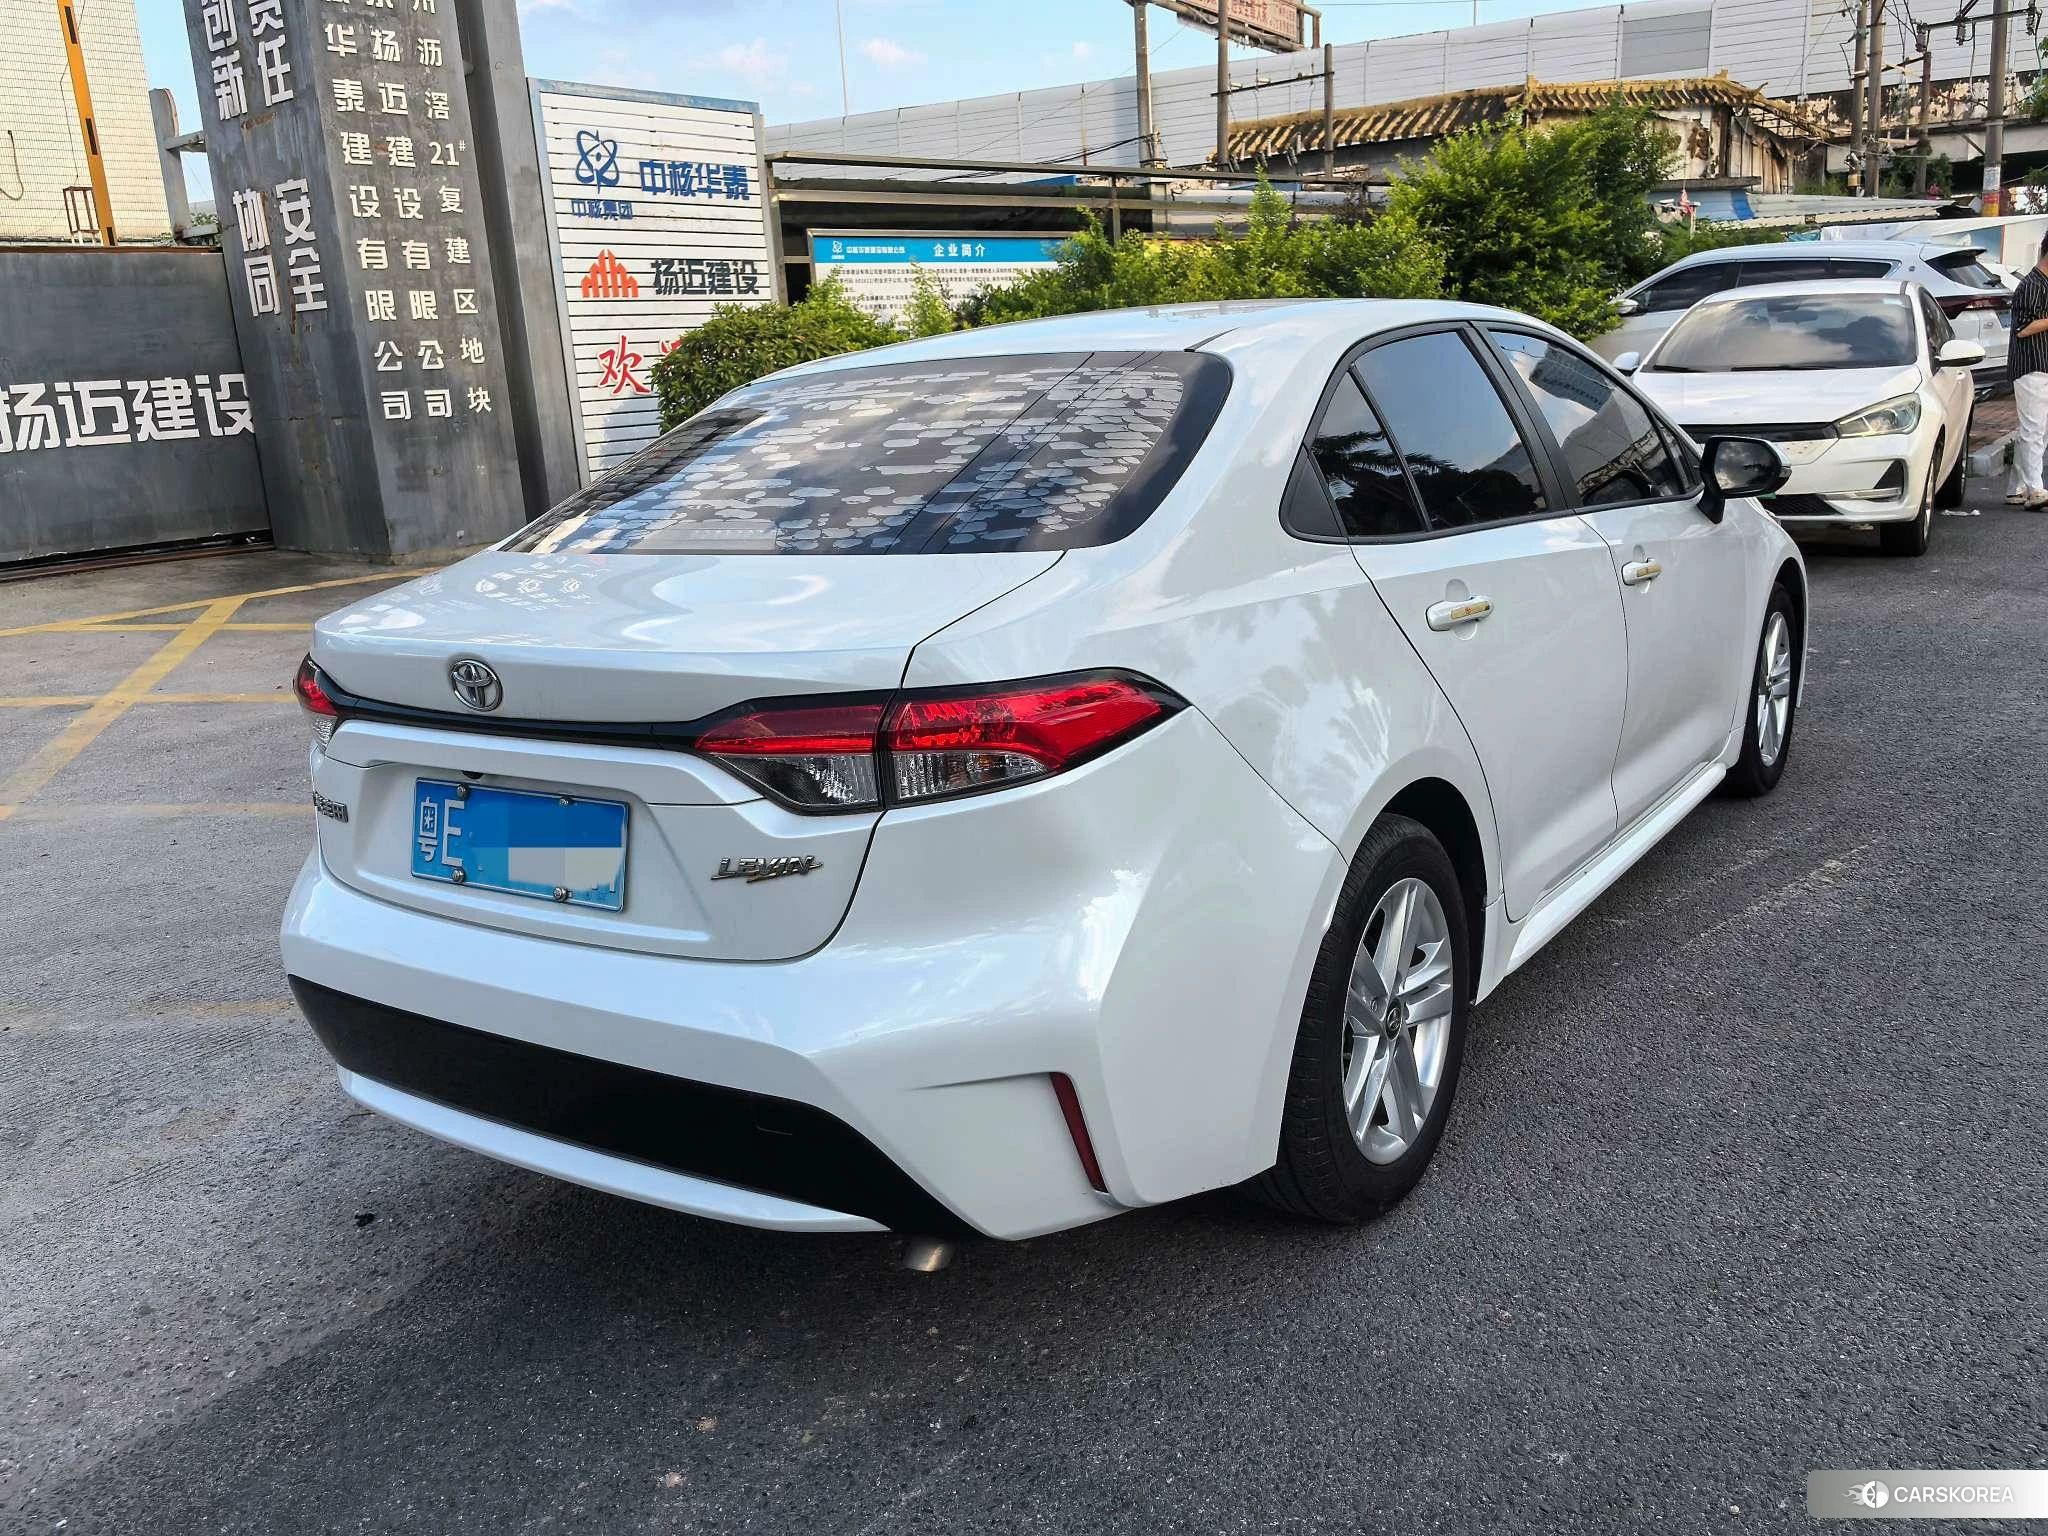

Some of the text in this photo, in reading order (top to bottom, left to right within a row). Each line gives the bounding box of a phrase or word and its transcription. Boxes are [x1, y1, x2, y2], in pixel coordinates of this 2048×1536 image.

[324, 0, 412, 420] 华泰建设有限公司
[366, 0, 454, 420] 扬迈建设有限公司
[570, 198, 633, 221] 中核集团
[639, 159, 751, 201] 中核华泰
[232, 188, 281, 318] 协同
[275, 178, 328, 313] 安全
[933, 243, 986, 257] 企业简介
[650, 258, 760, 296] 扬迈建设
[598, 334, 684, 396] 欢
[0, 373, 255, 453] 扬迈建设
[711, 856, 823, 883] LEVIN
